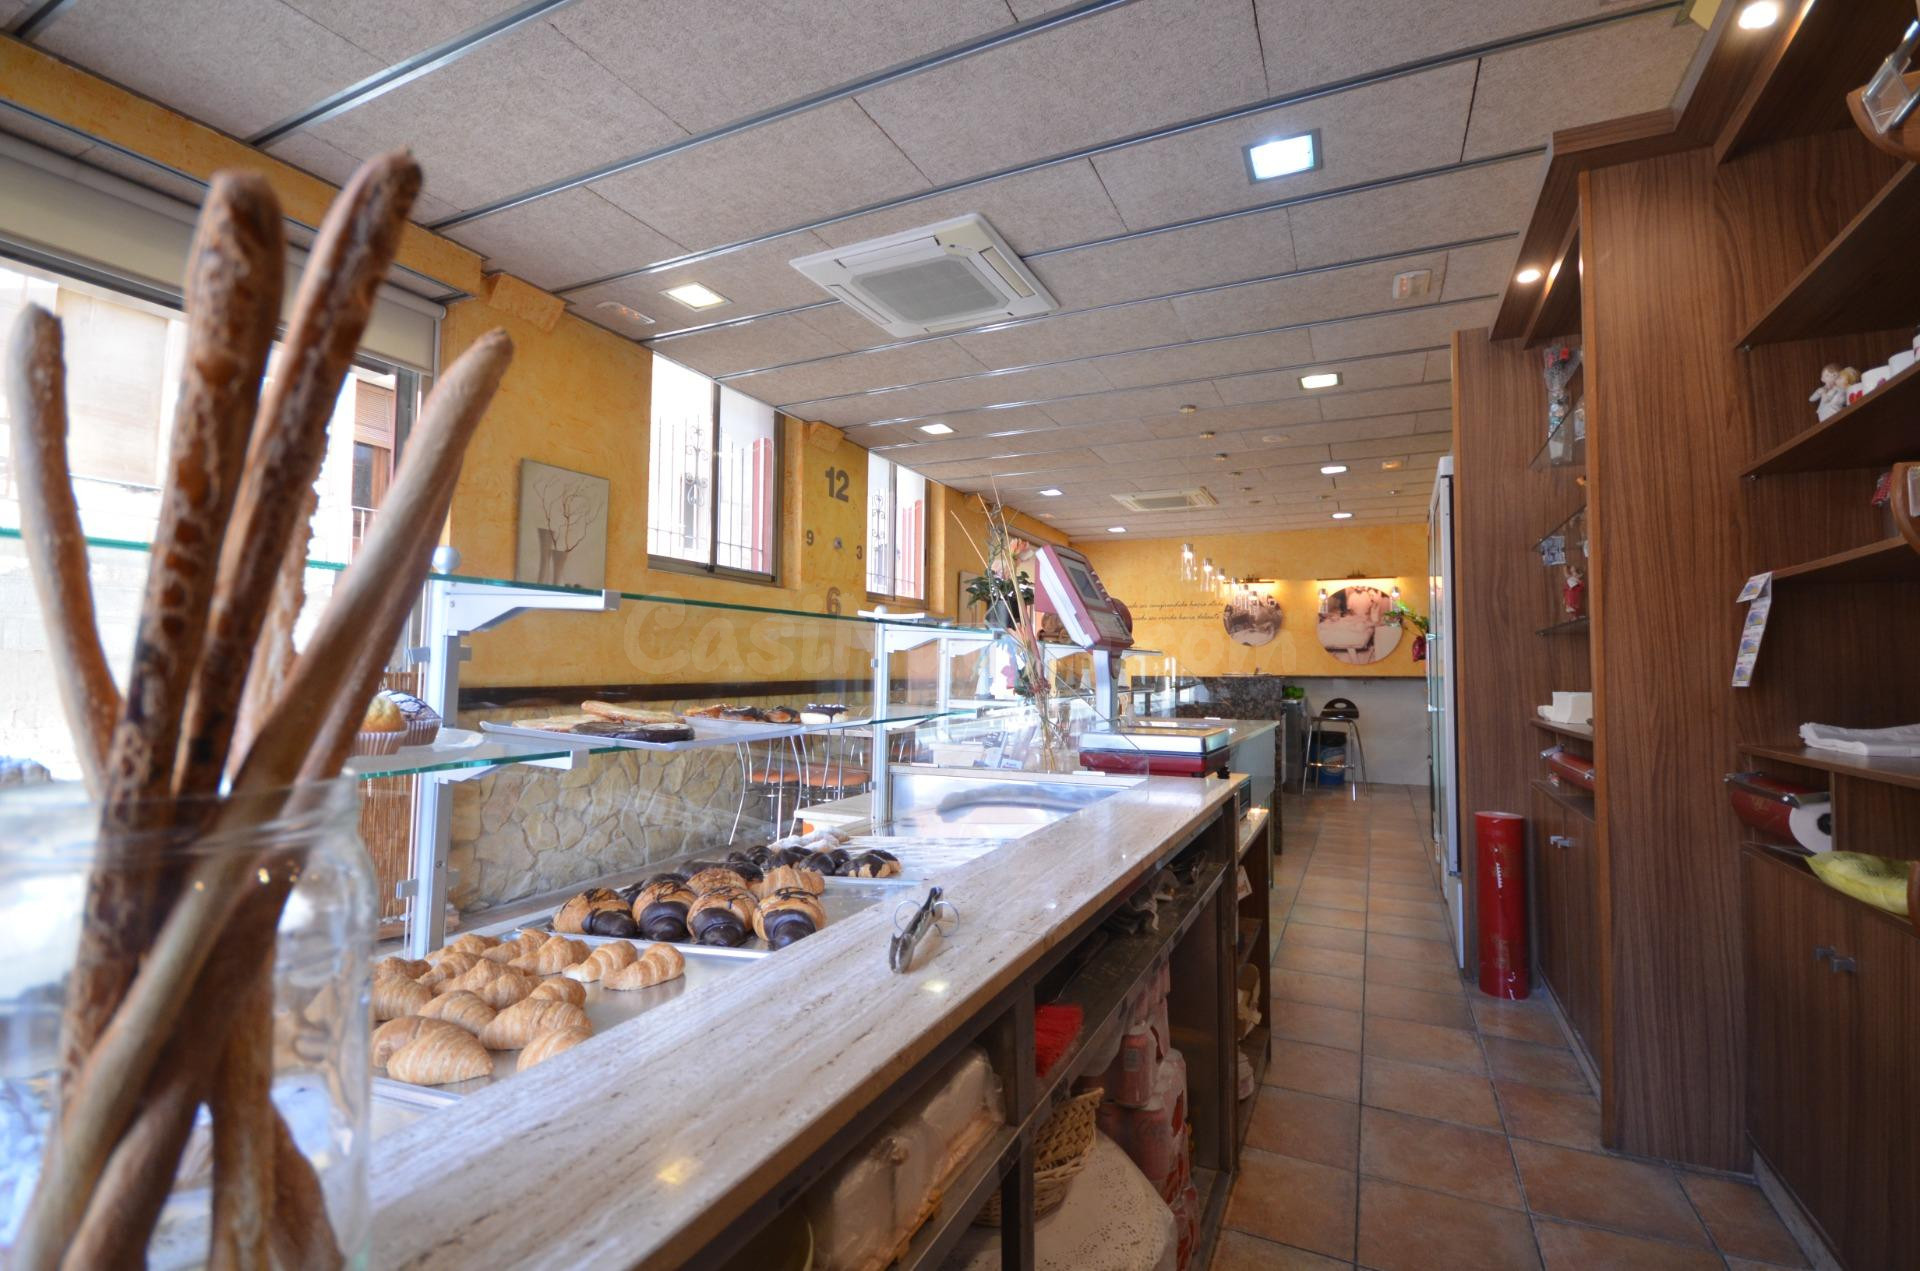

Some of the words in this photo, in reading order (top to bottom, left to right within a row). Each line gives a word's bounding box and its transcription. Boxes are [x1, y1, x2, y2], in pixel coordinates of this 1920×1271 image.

[825, 466, 849, 503] 12
[806, 530, 814, 546] 9
[856, 545, 863, 560] 3
[826, 586, 841, 617] 6
